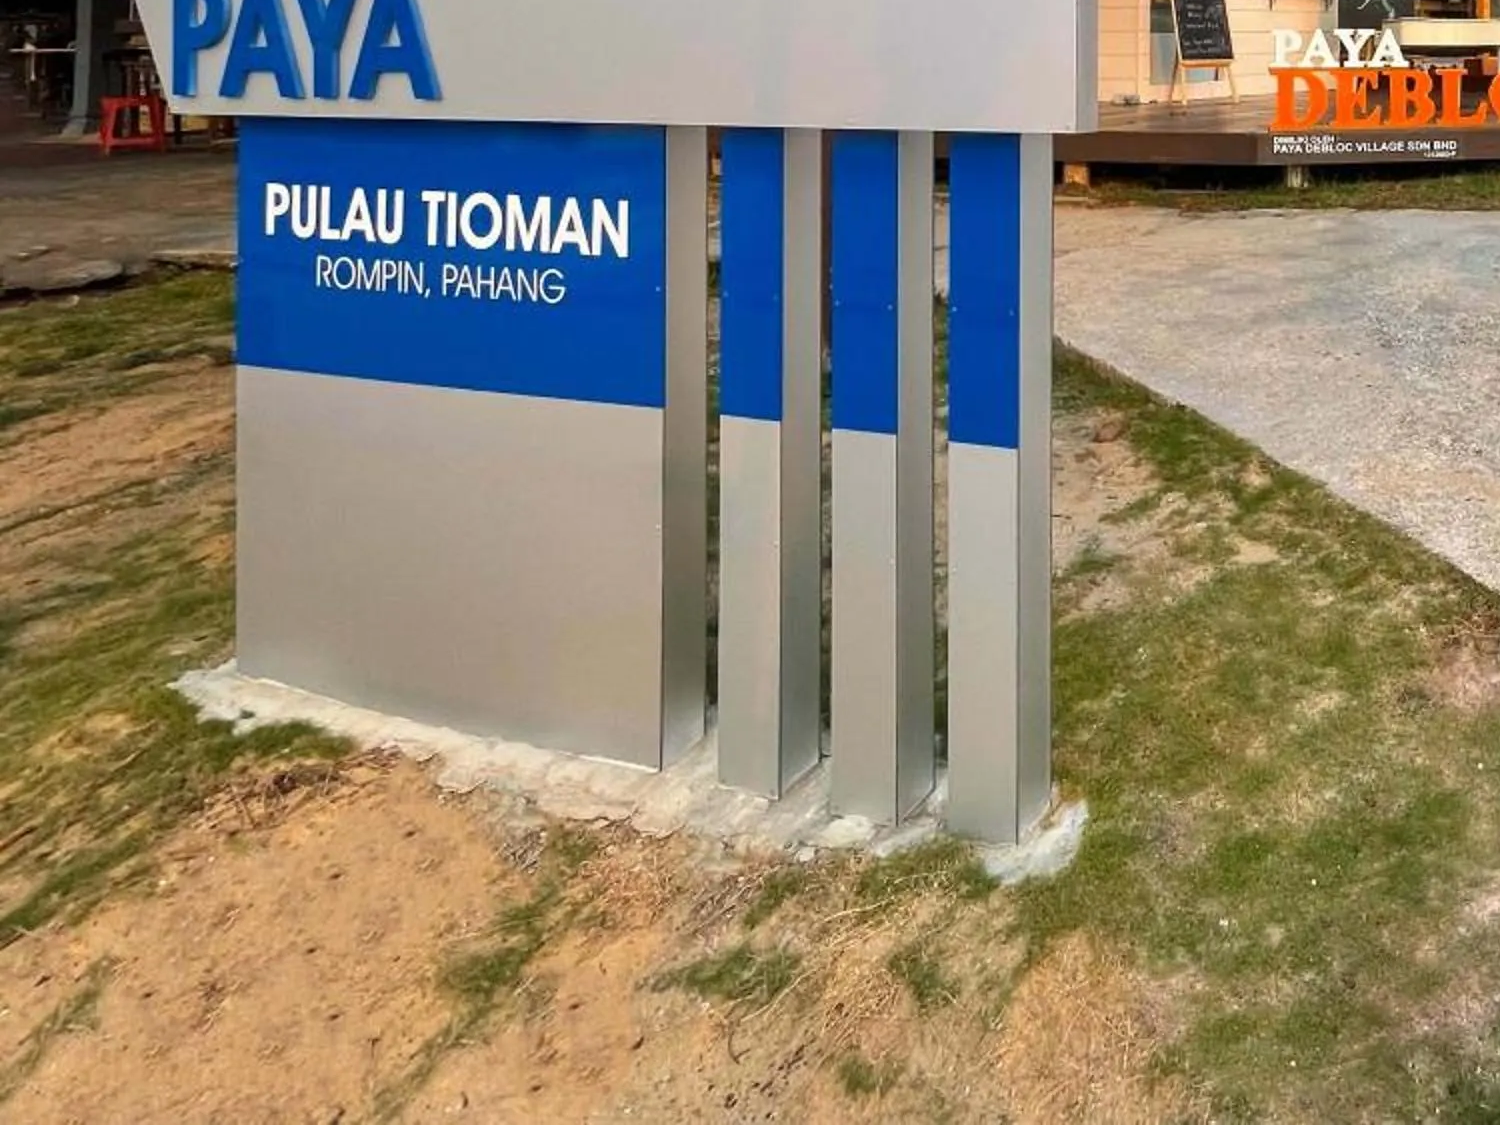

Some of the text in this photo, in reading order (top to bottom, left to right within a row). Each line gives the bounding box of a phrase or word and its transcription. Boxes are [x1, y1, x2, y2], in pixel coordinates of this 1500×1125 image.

[1271, 28, 1410, 68] PAYA
[1273, 141, 1457, 154] PAYA DEBLOC VILLAGE SDN BHD
[265, 182, 629, 258] PULAU TIOMAN
[315, 255, 566, 304] ROMPIN, PAHANG
